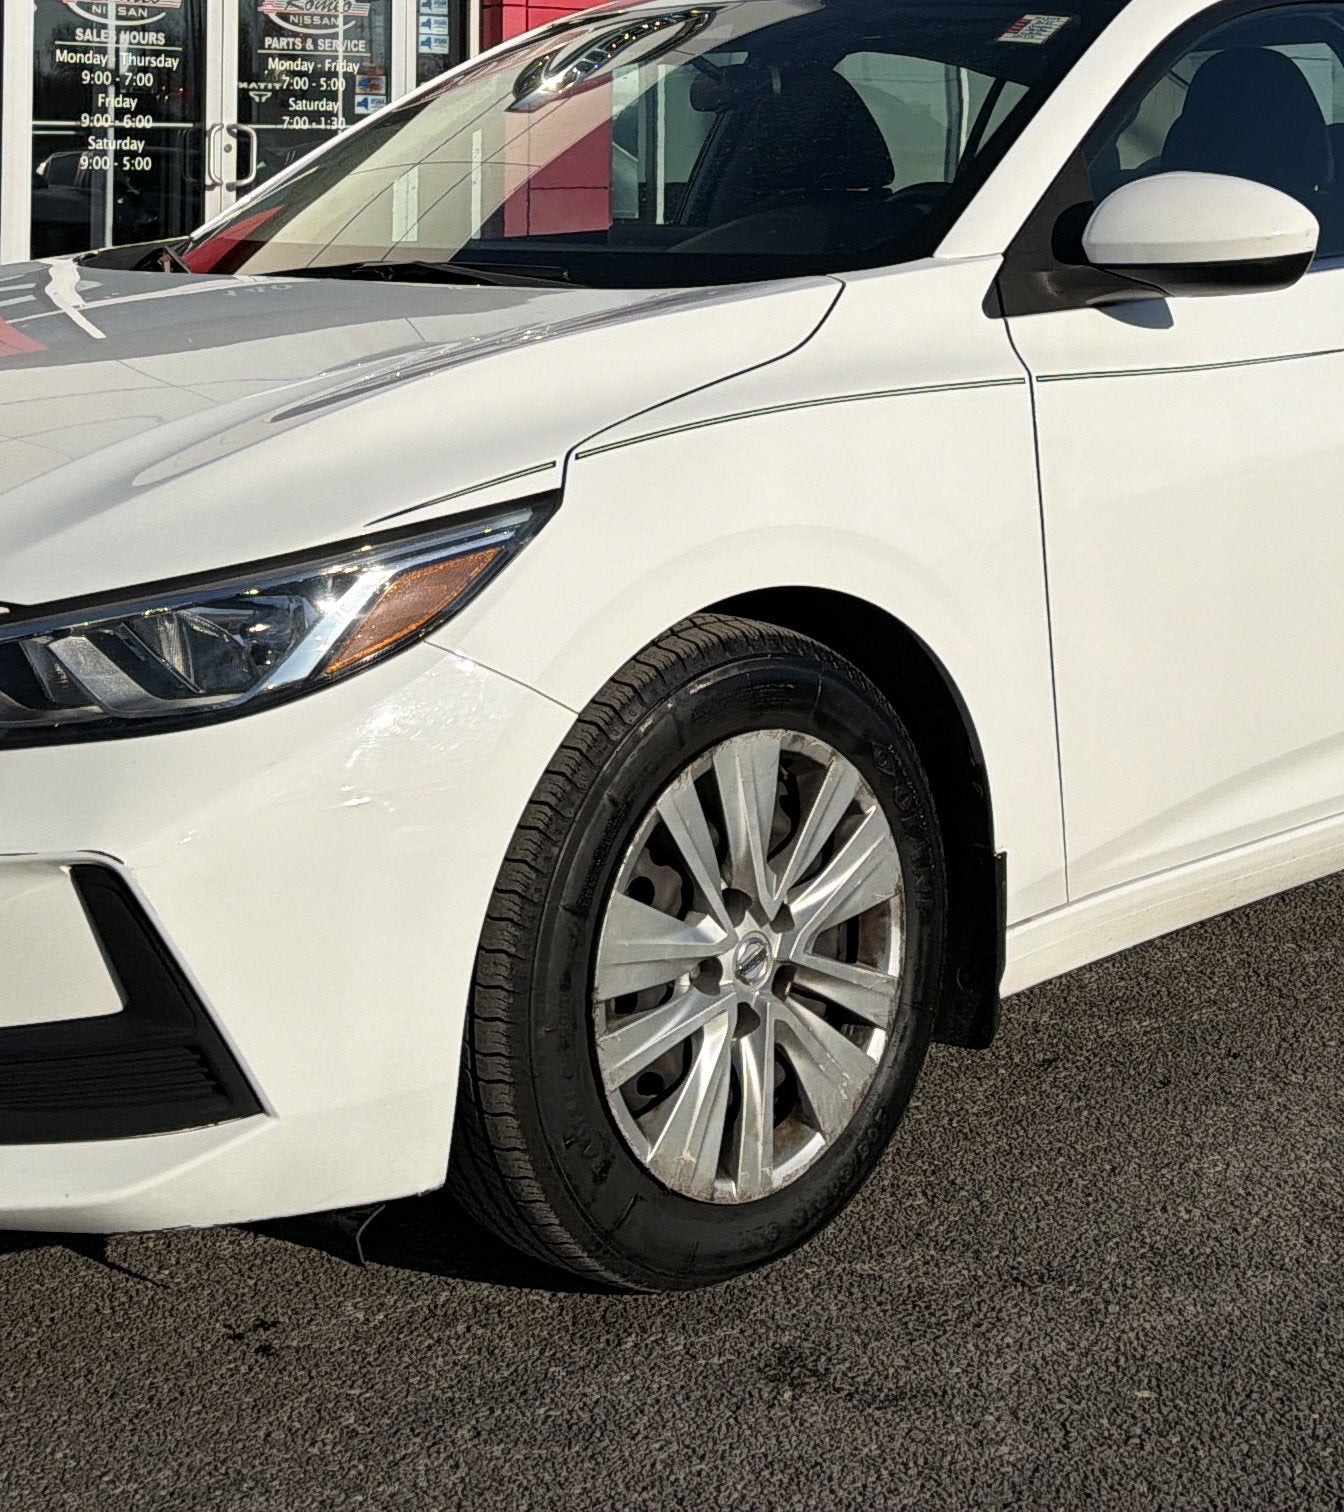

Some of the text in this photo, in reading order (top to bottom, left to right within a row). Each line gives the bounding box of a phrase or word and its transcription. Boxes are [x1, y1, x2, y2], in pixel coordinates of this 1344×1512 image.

[289, 15, 340, 26] NISSAN
[75, 28, 166, 45] SALES HOURS
[264, 37, 367, 52] PARTS & SERVICE
[56, 50, 108, 67] Monday
[120, 51, 179, 71] Thursday
[267, 57, 315, 73] Monday
[325, 59, 360, 75] Friday
[81, 70, 112, 85] 9:00
[124, 72, 154, 87] 7:00
[282, 75, 309, 90] 7:00
[319, 78, 346, 91] 5:00
[97, 94, 138, 111] Friday
[288, 98, 340, 113] Saturday
[80, 113, 111, 128] 9:00
[123, 115, 153, 129] 6:00
[281, 116, 309, 130] 7:00
[320, 117, 346, 130] 1:30
[88, 136, 145, 153] Saturday
[79, 156, 110, 170] 9:00
[122, 157, 152, 171] 5:00
